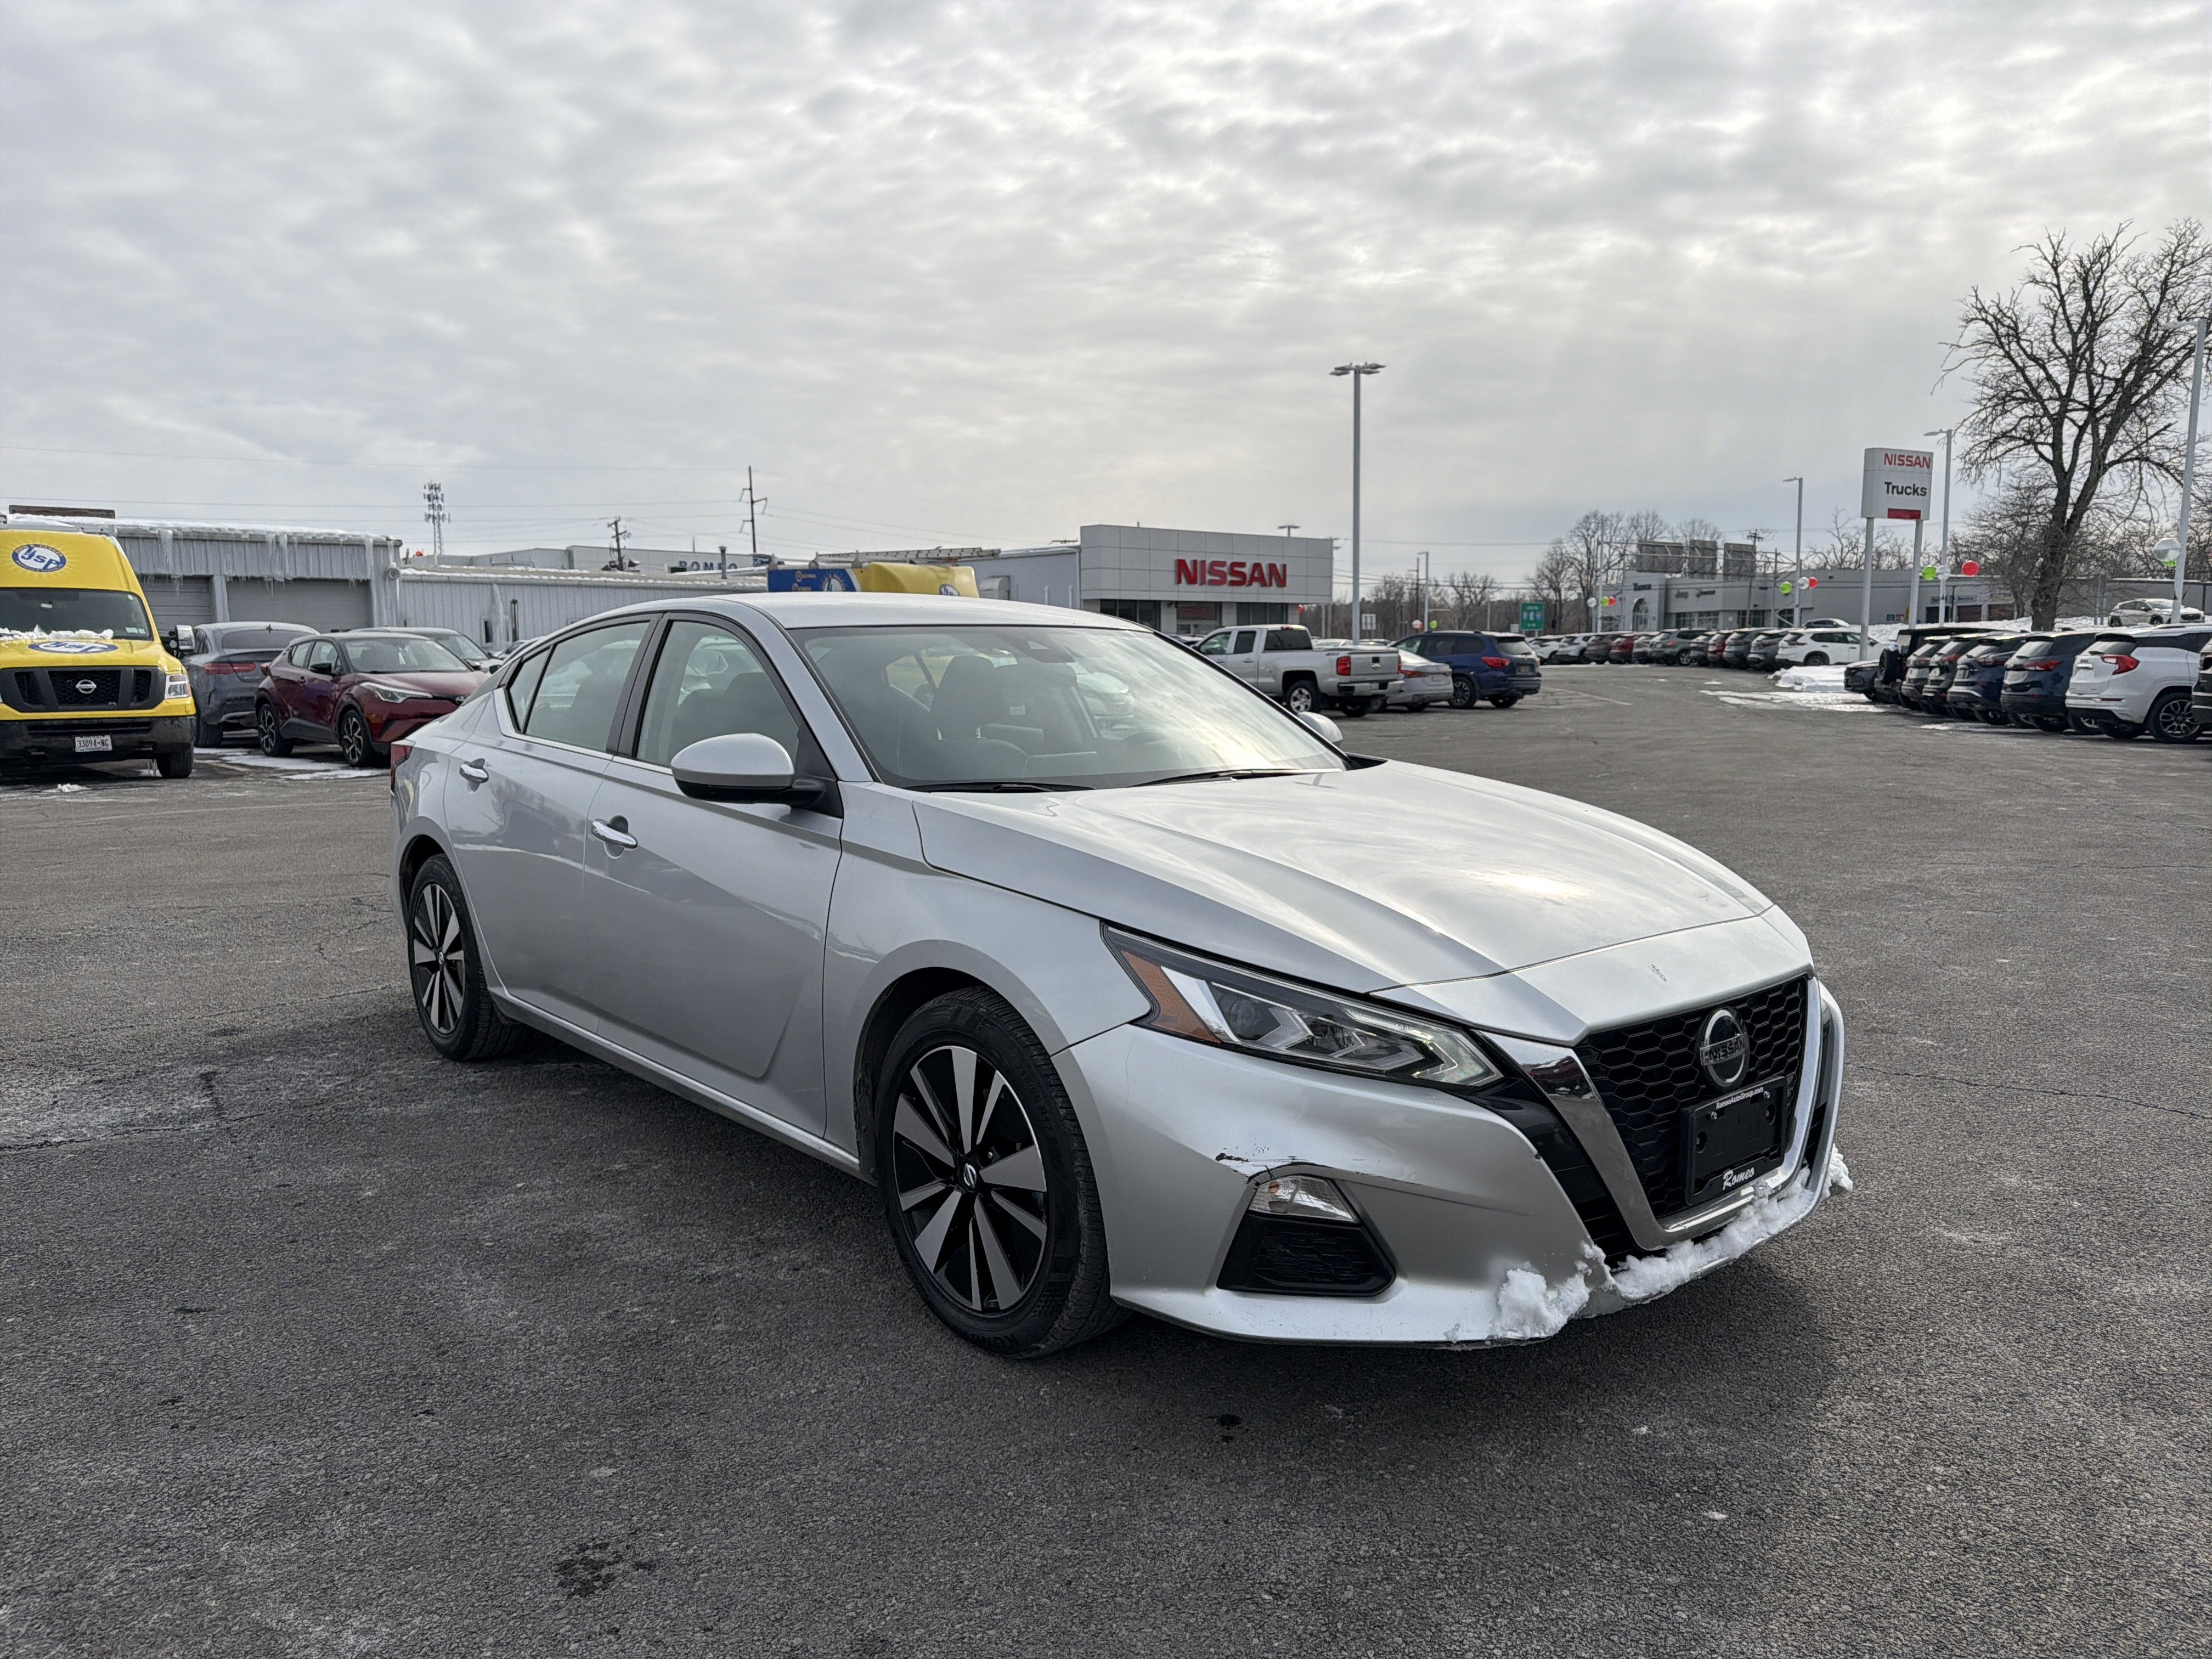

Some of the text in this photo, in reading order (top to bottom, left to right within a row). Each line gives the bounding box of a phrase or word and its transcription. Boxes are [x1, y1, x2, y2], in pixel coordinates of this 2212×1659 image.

[1884, 453, 1931, 469] NISSAN
[1884, 481, 1927, 496] Trucks
[1176, 558, 1287, 588] NISSAN
[1709, 1036, 1745, 1060] NISSAN
[1716, 1086, 1764, 1110] RomeoAutoGroup.com
[1723, 1167, 1755, 1191] Romeo
